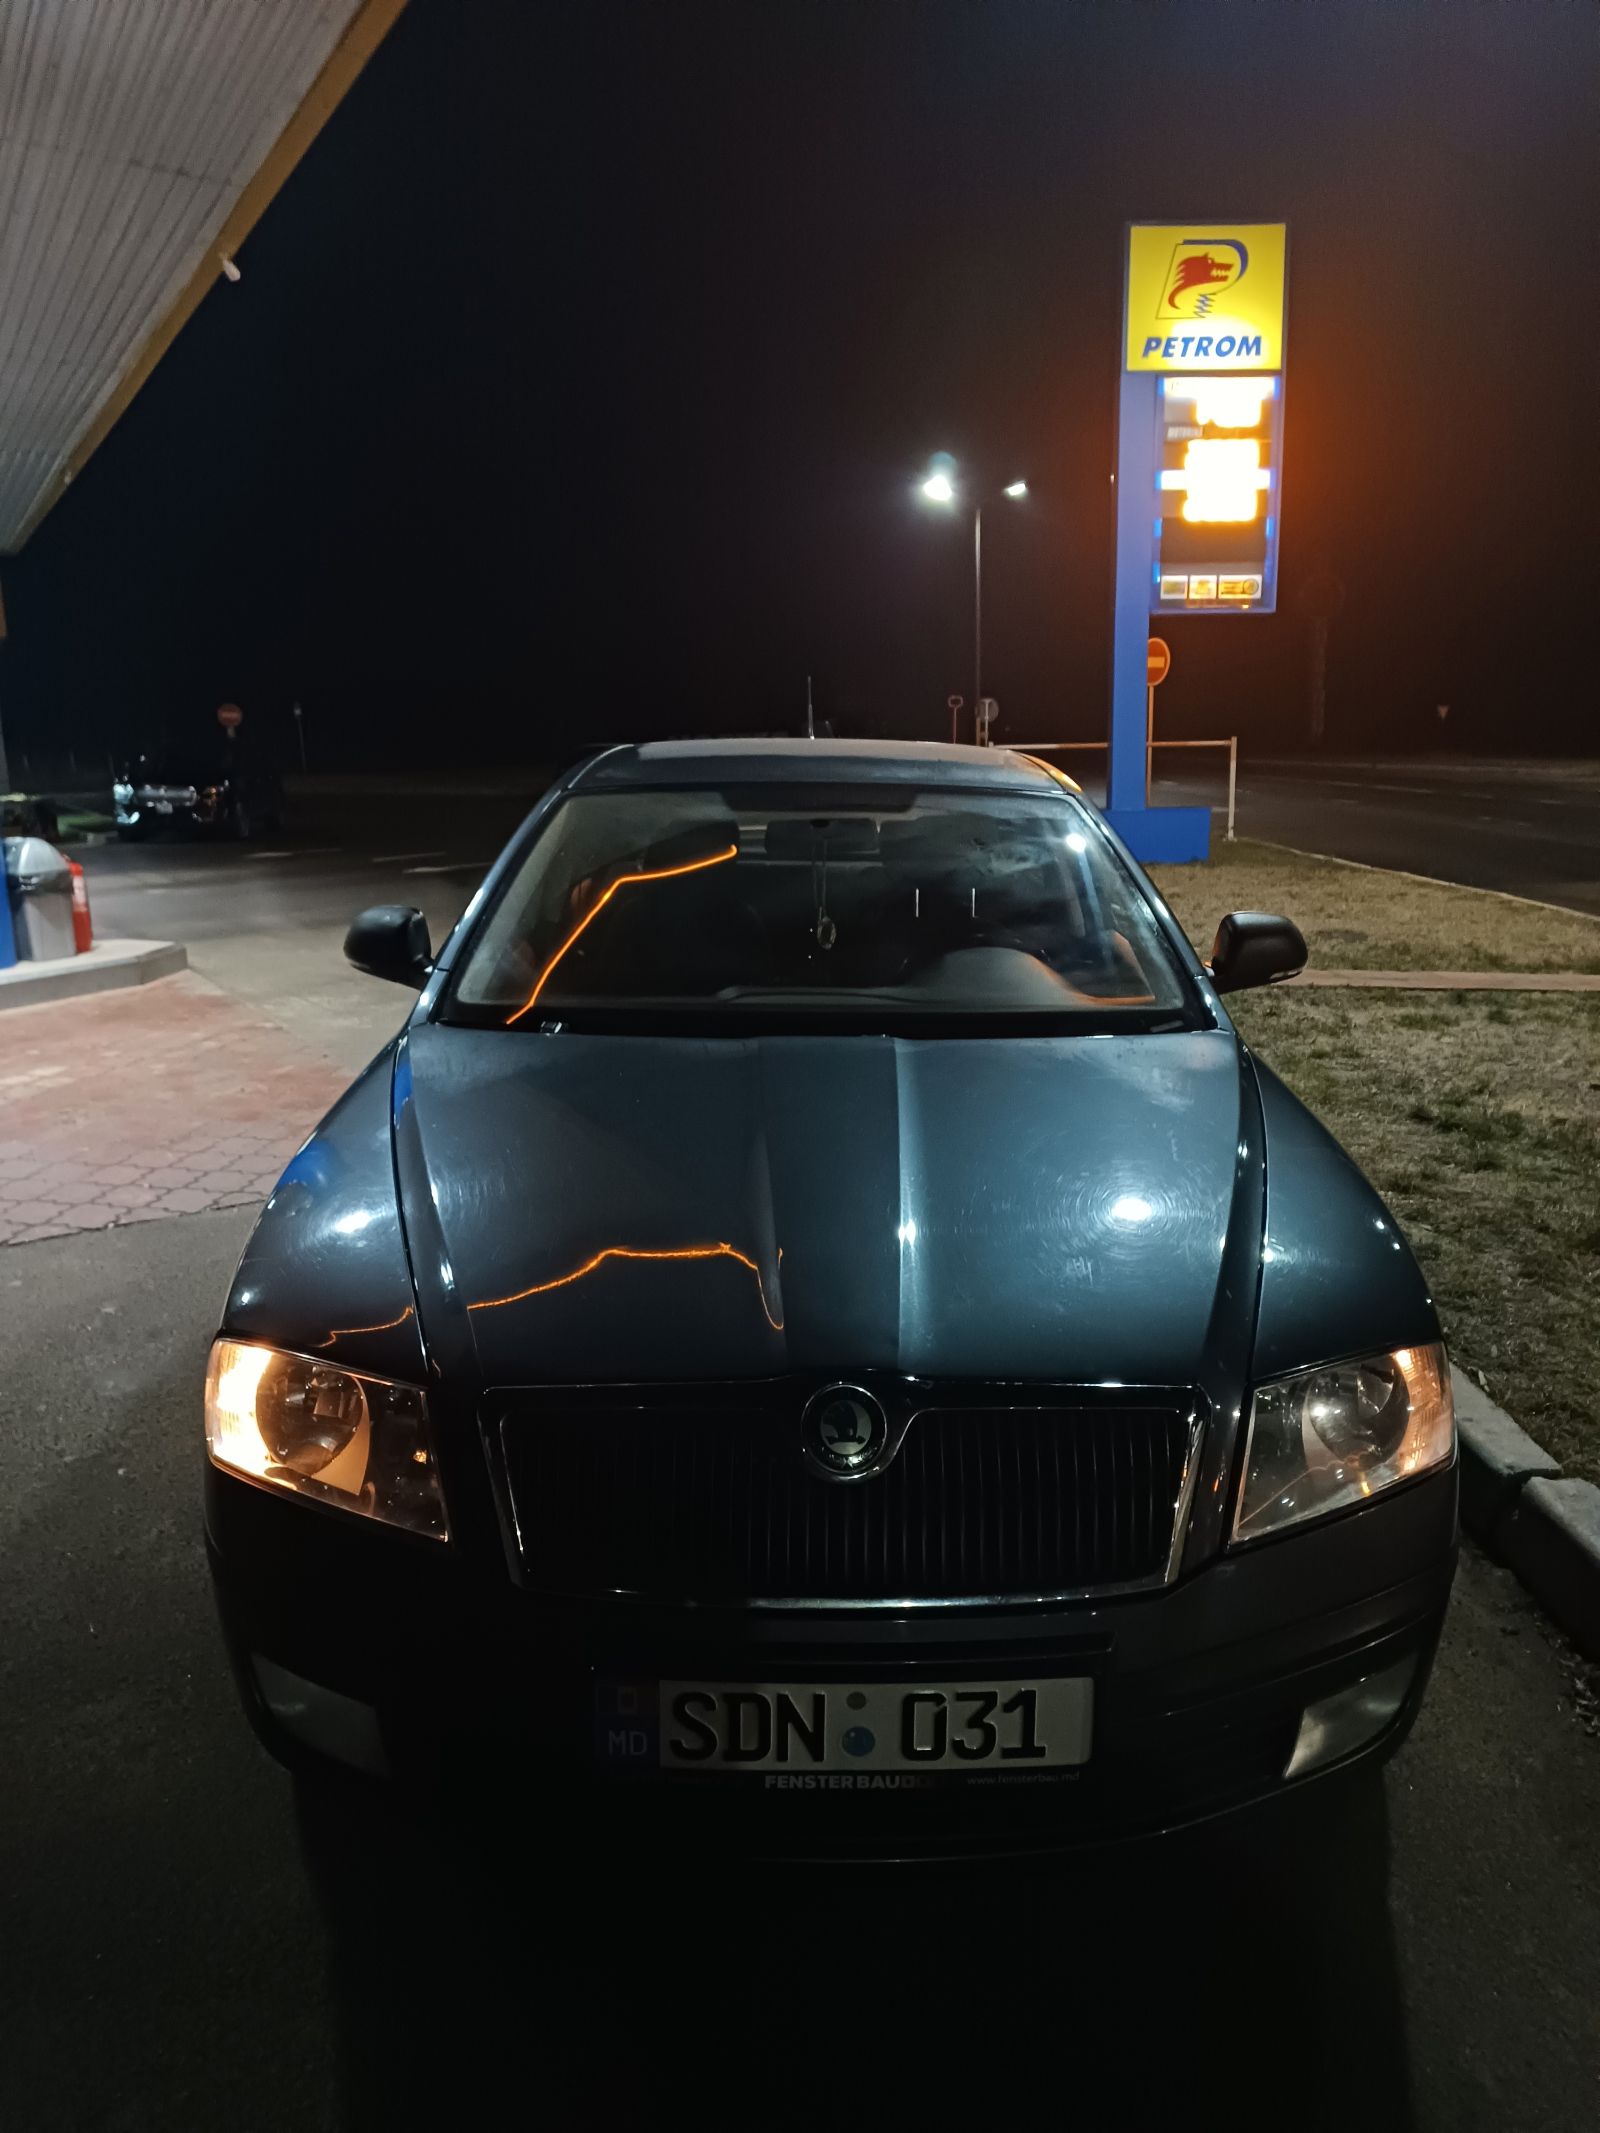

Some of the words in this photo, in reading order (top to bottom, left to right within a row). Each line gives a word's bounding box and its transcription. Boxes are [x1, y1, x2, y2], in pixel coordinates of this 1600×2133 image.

[1142, 335, 1262, 358] PETROM
[669, 1690, 828, 1762] SDN
[902, 1689, 1047, 1761] 031
[608, 1728, 649, 1756] MD
